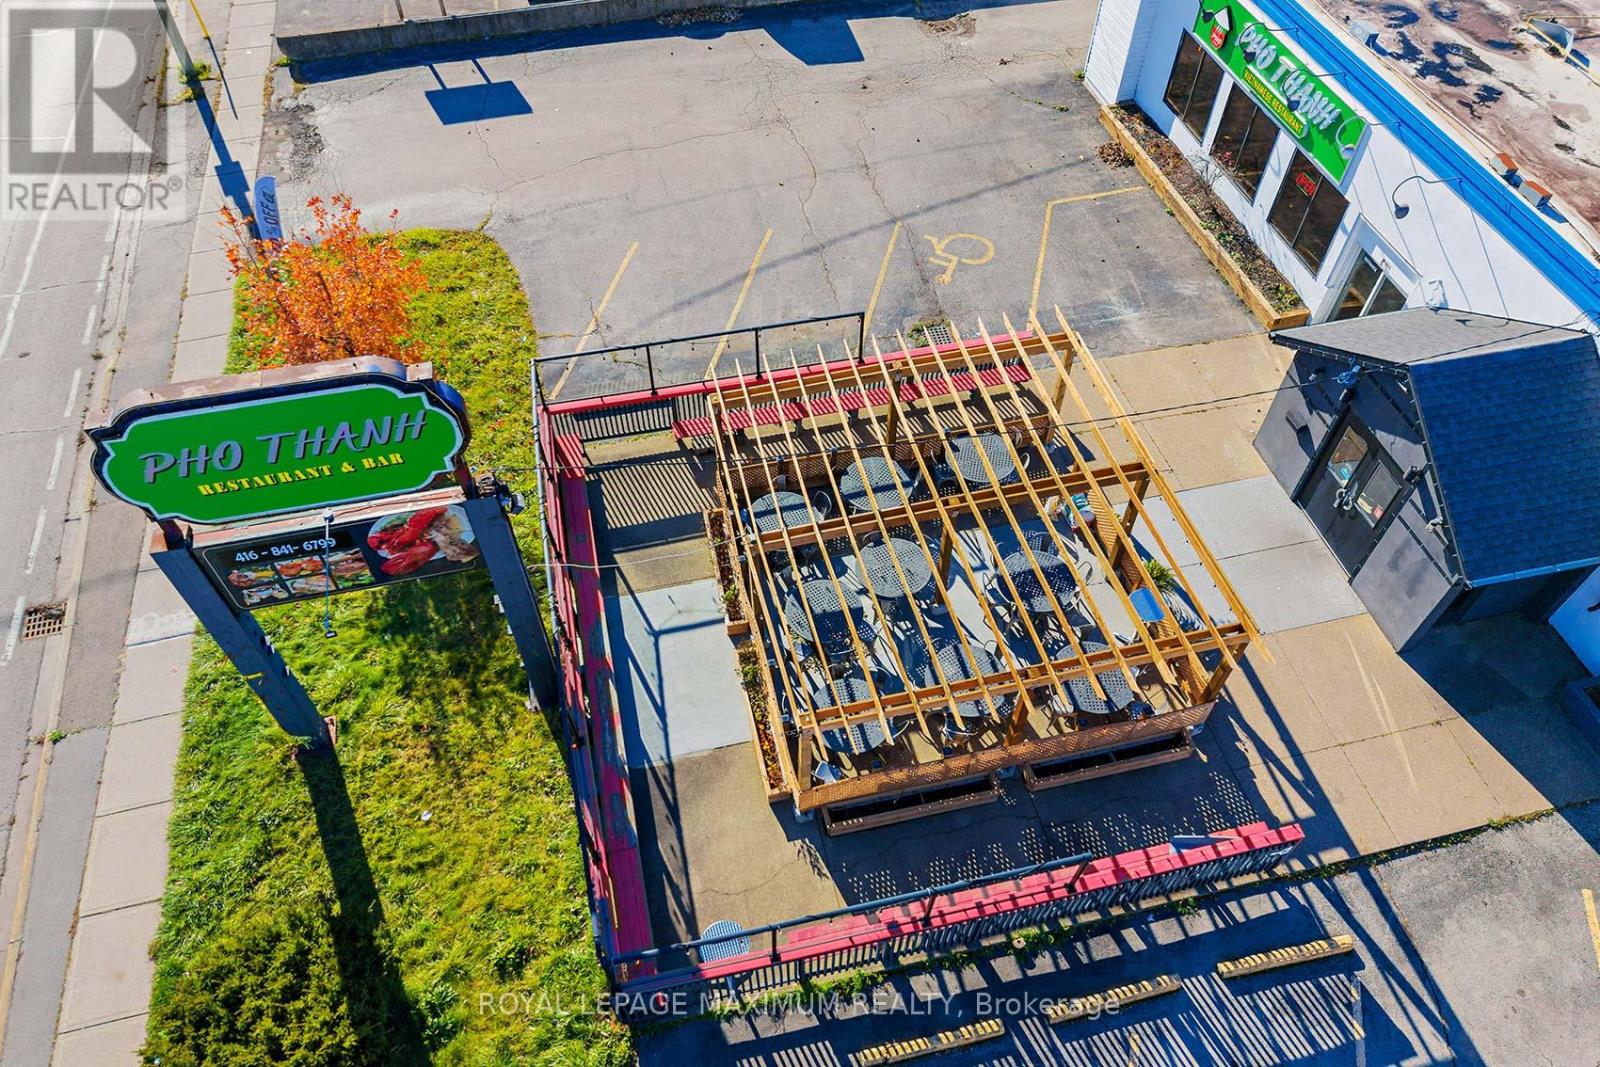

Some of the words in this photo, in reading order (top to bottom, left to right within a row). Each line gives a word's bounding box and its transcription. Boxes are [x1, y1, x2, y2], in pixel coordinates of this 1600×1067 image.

[1236, 23, 1277, 70] PHO
[1271, 56, 1342, 130] THANH
[1244, 68, 1273, 104] VIETNAMESE
[1271, 98, 1303, 134] RESTAURANT
[260, 202, 279, 225] OFF
[139, 441, 242, 484] PHO
[256, 410, 427, 465] THANH
[197, 464, 333, 496] RESTAURANT
[340, 461, 355, 474] &
[362, 452, 404, 470] BAR
[235, 550, 259, 562] 416
[303, 537, 336, 551] 6799
